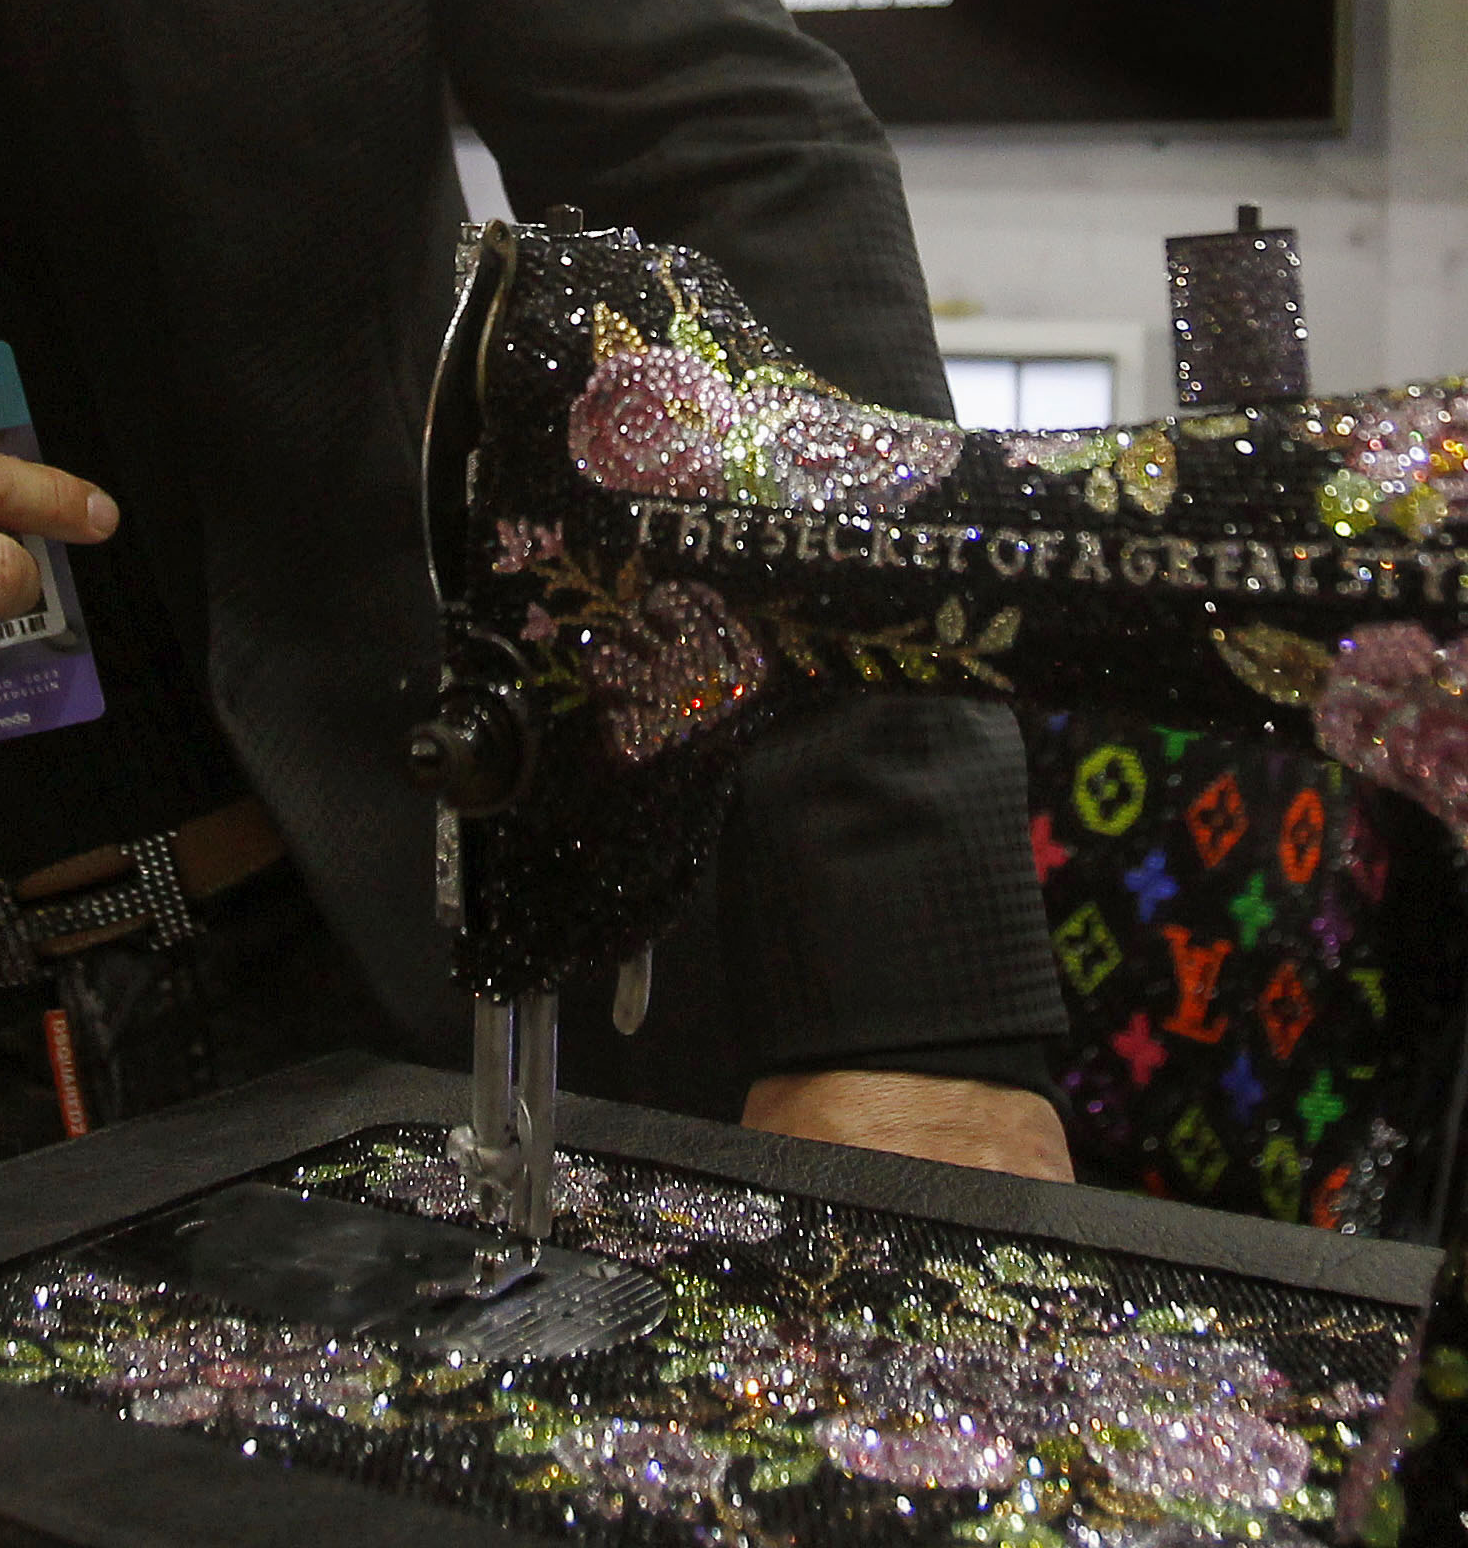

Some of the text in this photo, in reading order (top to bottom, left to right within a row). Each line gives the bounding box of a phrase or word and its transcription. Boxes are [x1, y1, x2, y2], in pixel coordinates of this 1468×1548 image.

[762, 508, 985, 572] SECRET
[988, 528, 1065, 580] OF
[1069, 529, 1111, 583] A
[1119, 536, 1332, 593] GREAT
